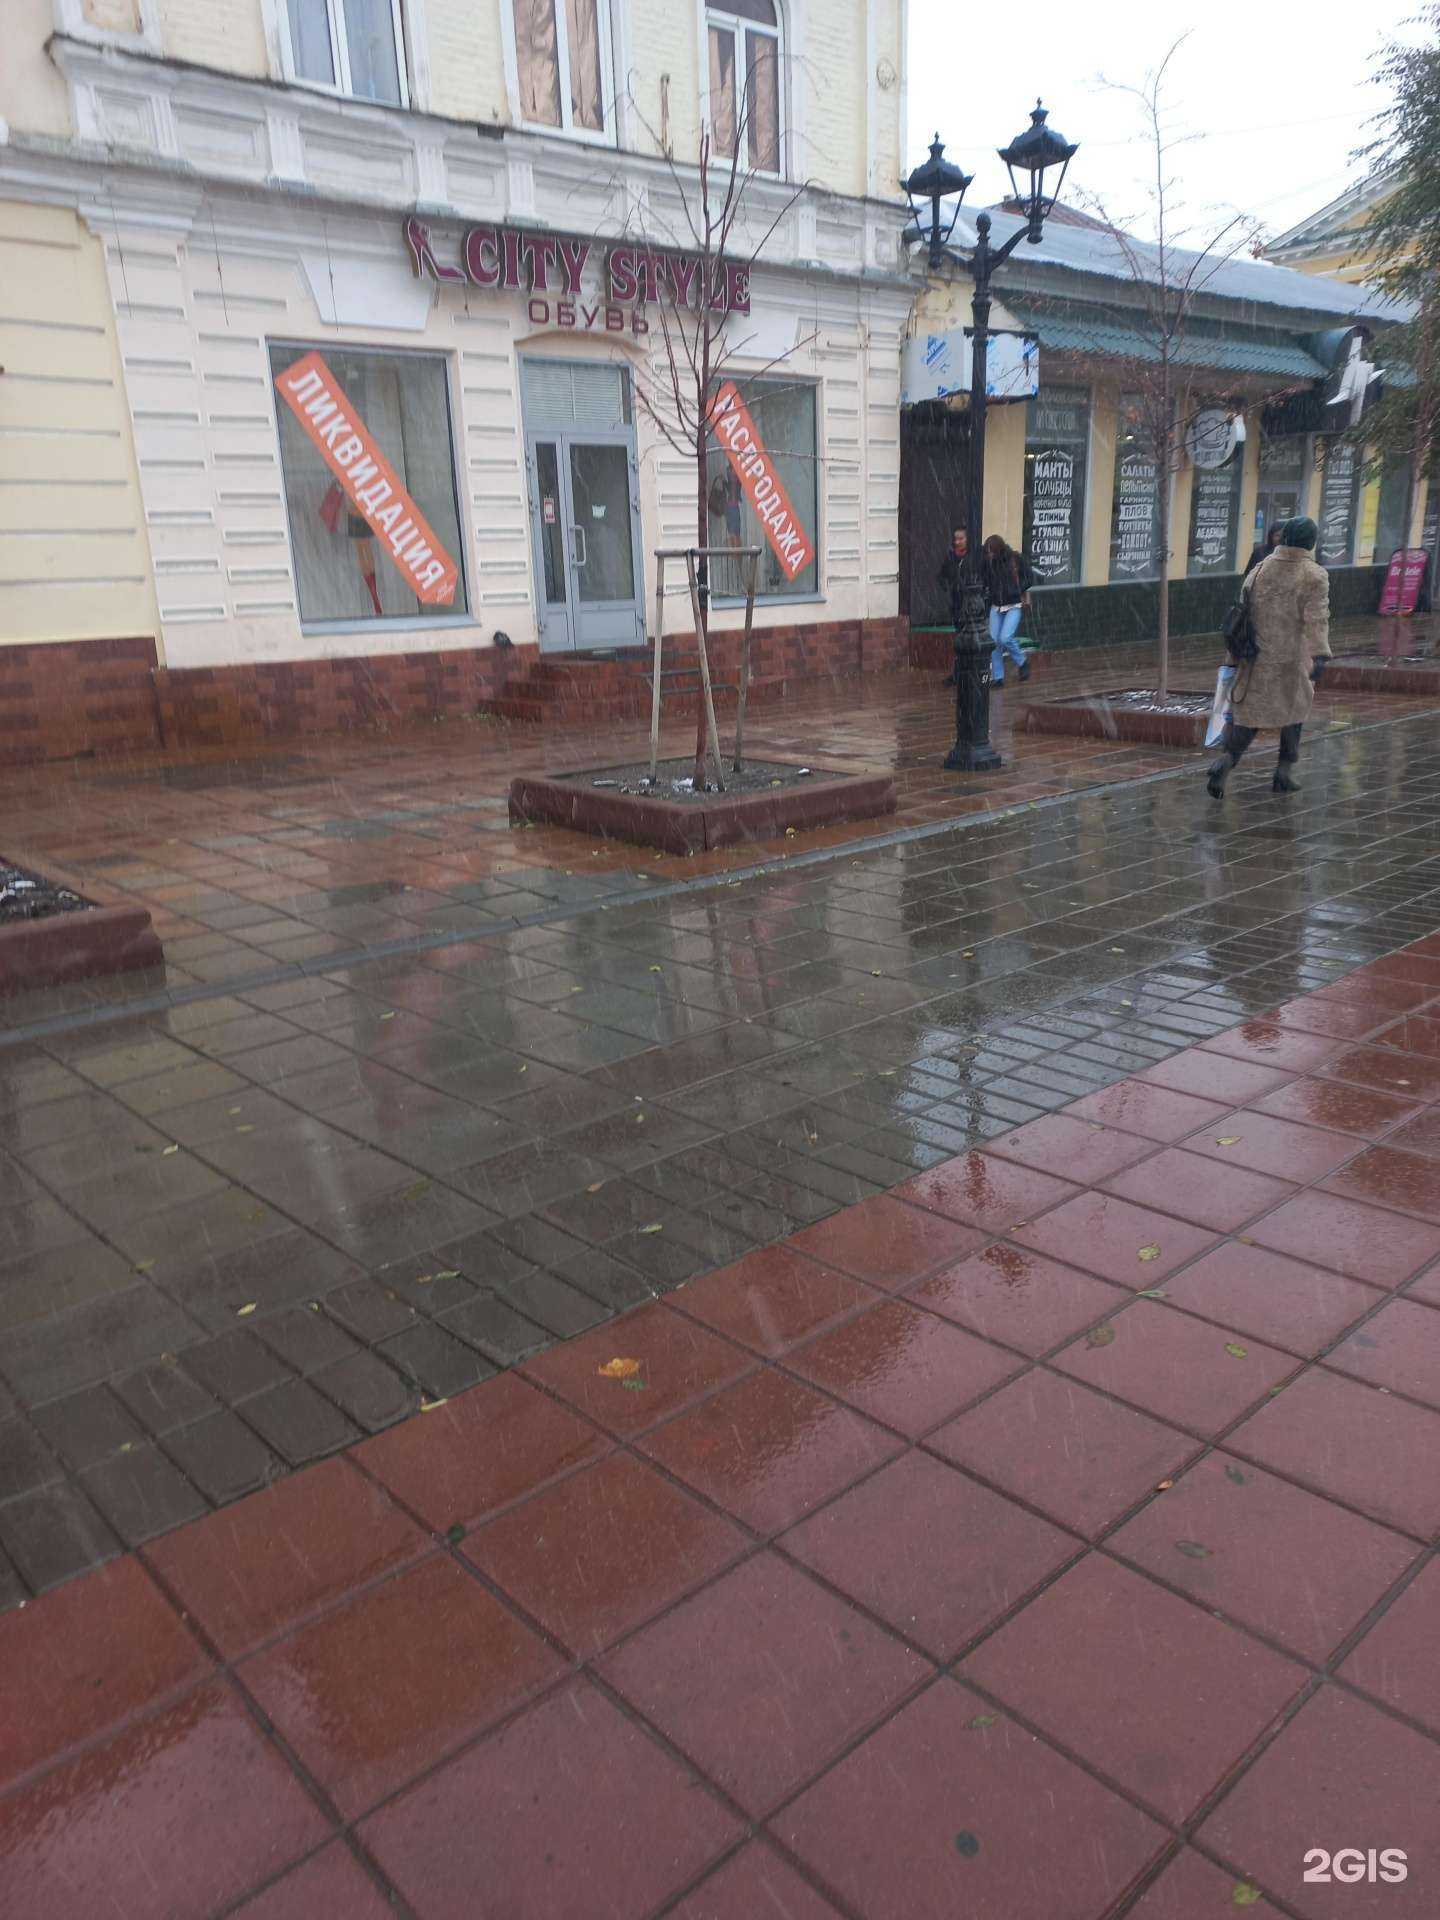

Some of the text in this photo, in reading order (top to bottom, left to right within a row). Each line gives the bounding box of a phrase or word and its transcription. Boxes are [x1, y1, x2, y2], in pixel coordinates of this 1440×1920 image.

[464, 224, 752, 314] CITY STYLE
[528, 299, 650, 336] ОБУВЬ
[1034, 461, 1074, 479] МАНТЫ
[288, 369, 446, 590] ЛИКВИДАЦИЯ
[1033, 480, 1073, 498] ГОЛУБЦЫ
[1124, 506, 1149, 517] ПЛОВ
[1038, 526, 1065, 538] ГУЛЯШ
